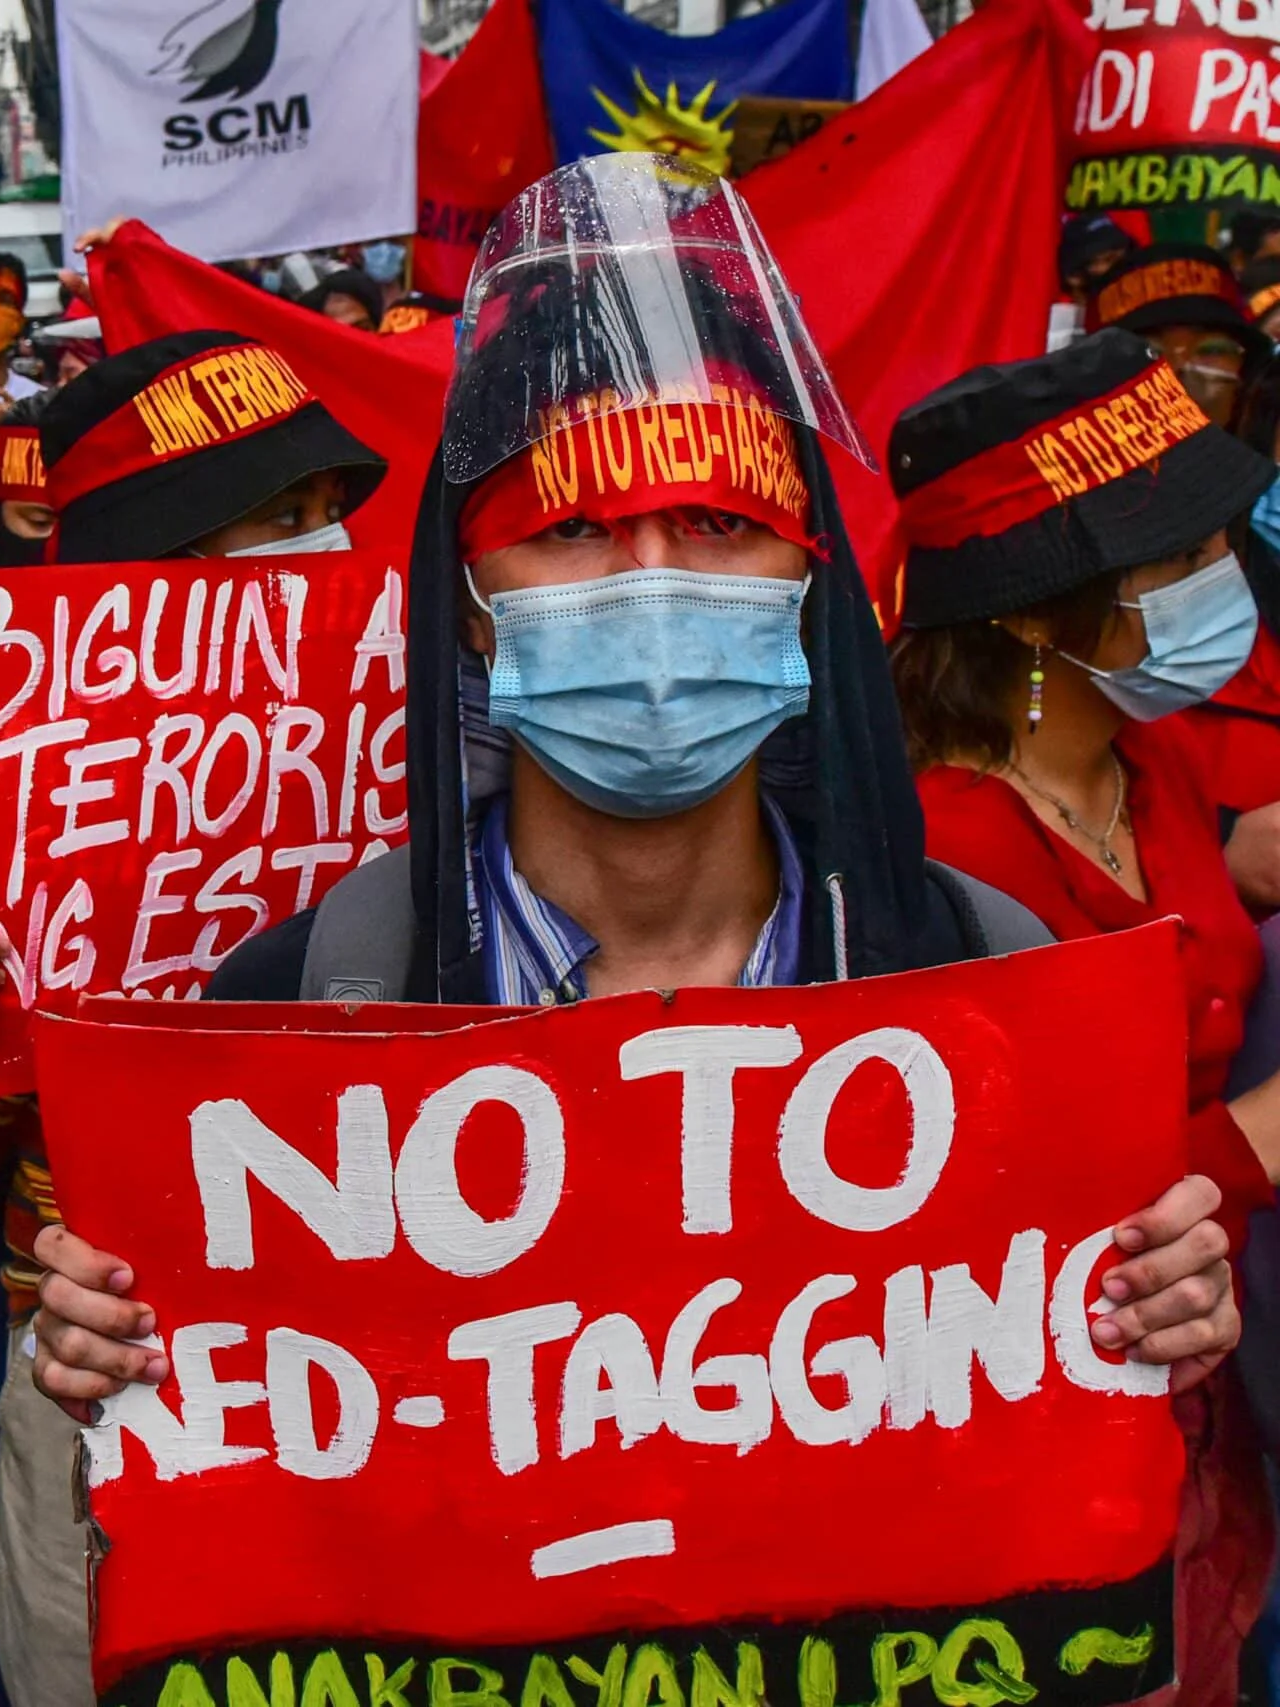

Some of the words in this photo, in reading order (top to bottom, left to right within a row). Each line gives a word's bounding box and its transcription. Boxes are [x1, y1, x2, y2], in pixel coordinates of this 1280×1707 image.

[162, 134, 309, 170] PHILIPPINES
[163, 94, 310, 151] SCM
[132, 370, 221, 457] JUNK
[527, 403, 579, 514] NO
[577, 386, 632, 492] TO
[1024, 432, 1088, 502] NO
[1059, 415, 1124, 485] TO
[122, 837, 395, 989] EST
[189, 1064, 566, 1279] NO
[618, 1023, 954, 1235] TO
[156, 1642, 765, 1707] ANAKBAYAN
